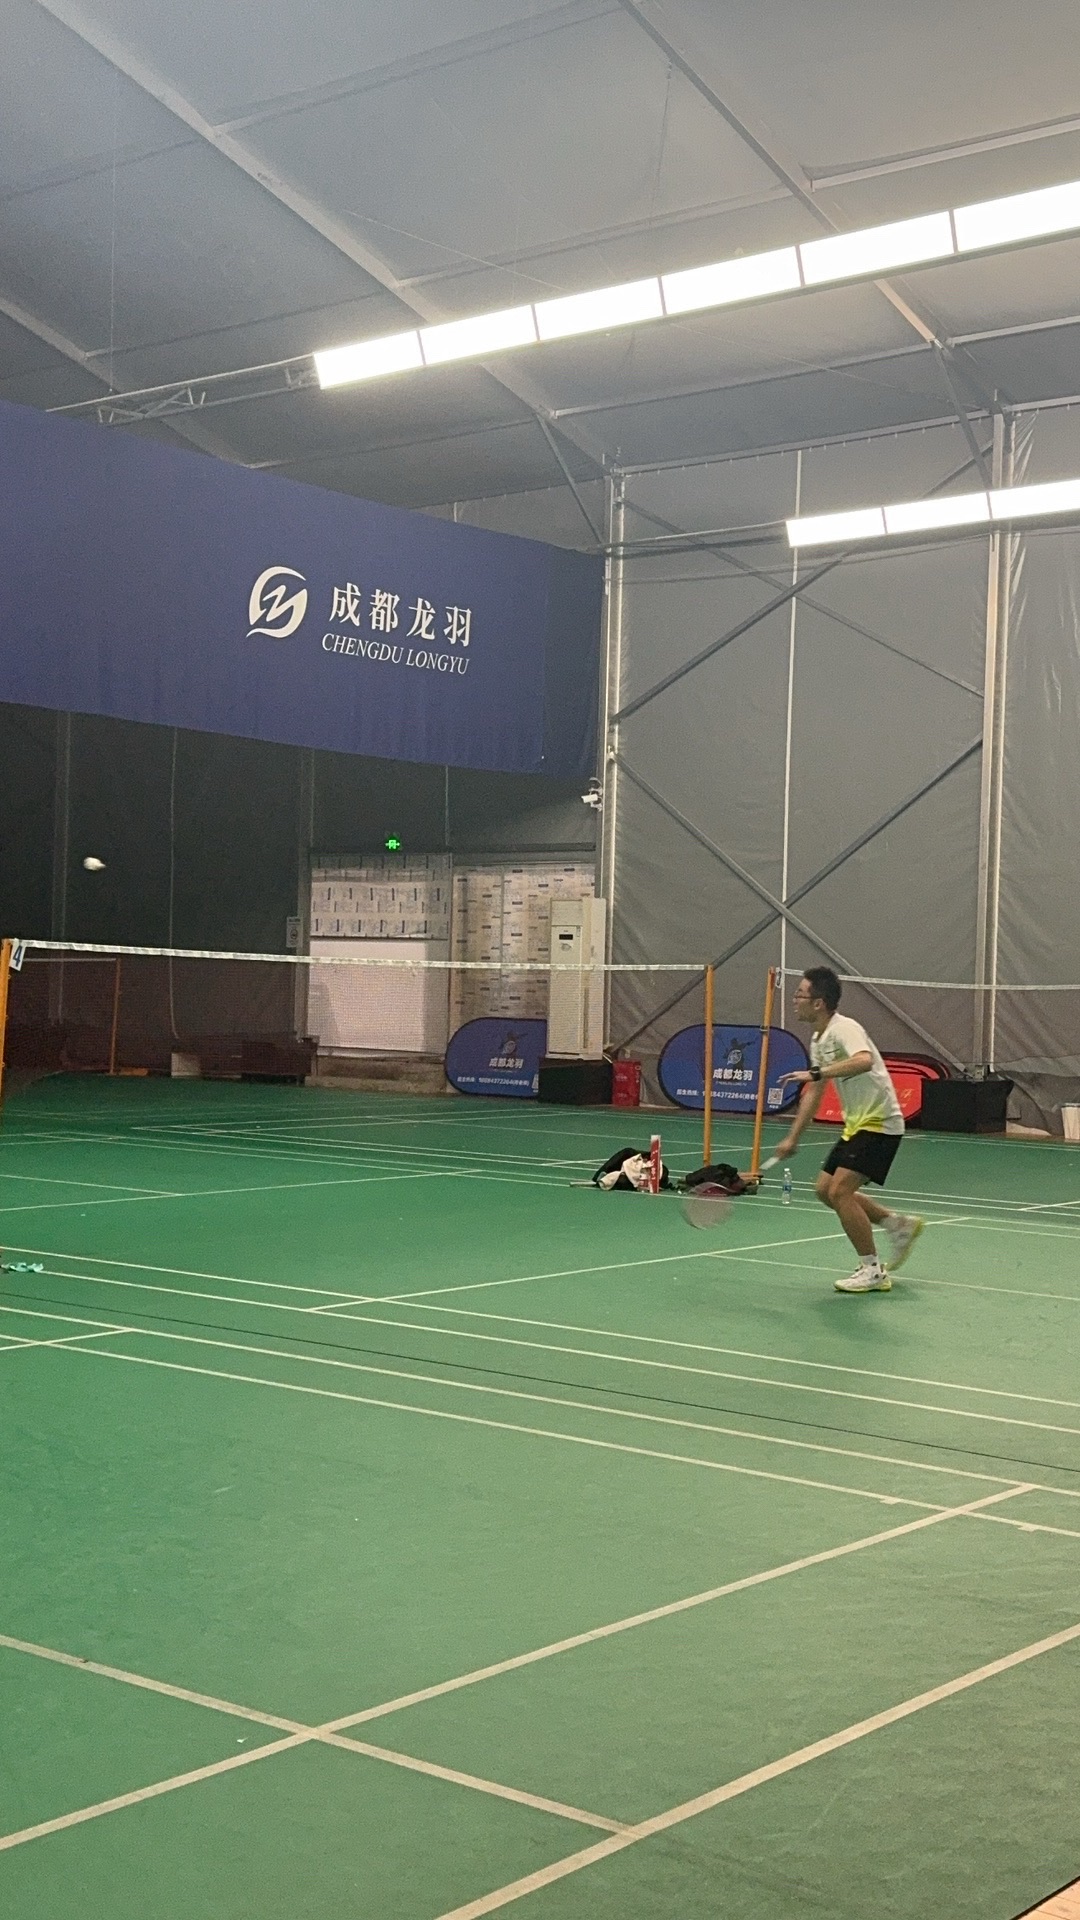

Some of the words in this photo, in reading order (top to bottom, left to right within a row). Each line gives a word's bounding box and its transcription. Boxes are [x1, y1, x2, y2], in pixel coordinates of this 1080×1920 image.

[329, 582, 472, 647] 成都龙羽
[322, 633, 404, 664] CHENGDU
[406, 649, 470, 675] LONGYU
[13, 945, 23, 967] 4
[712, 1068, 753, 1081] 成都龙羽
